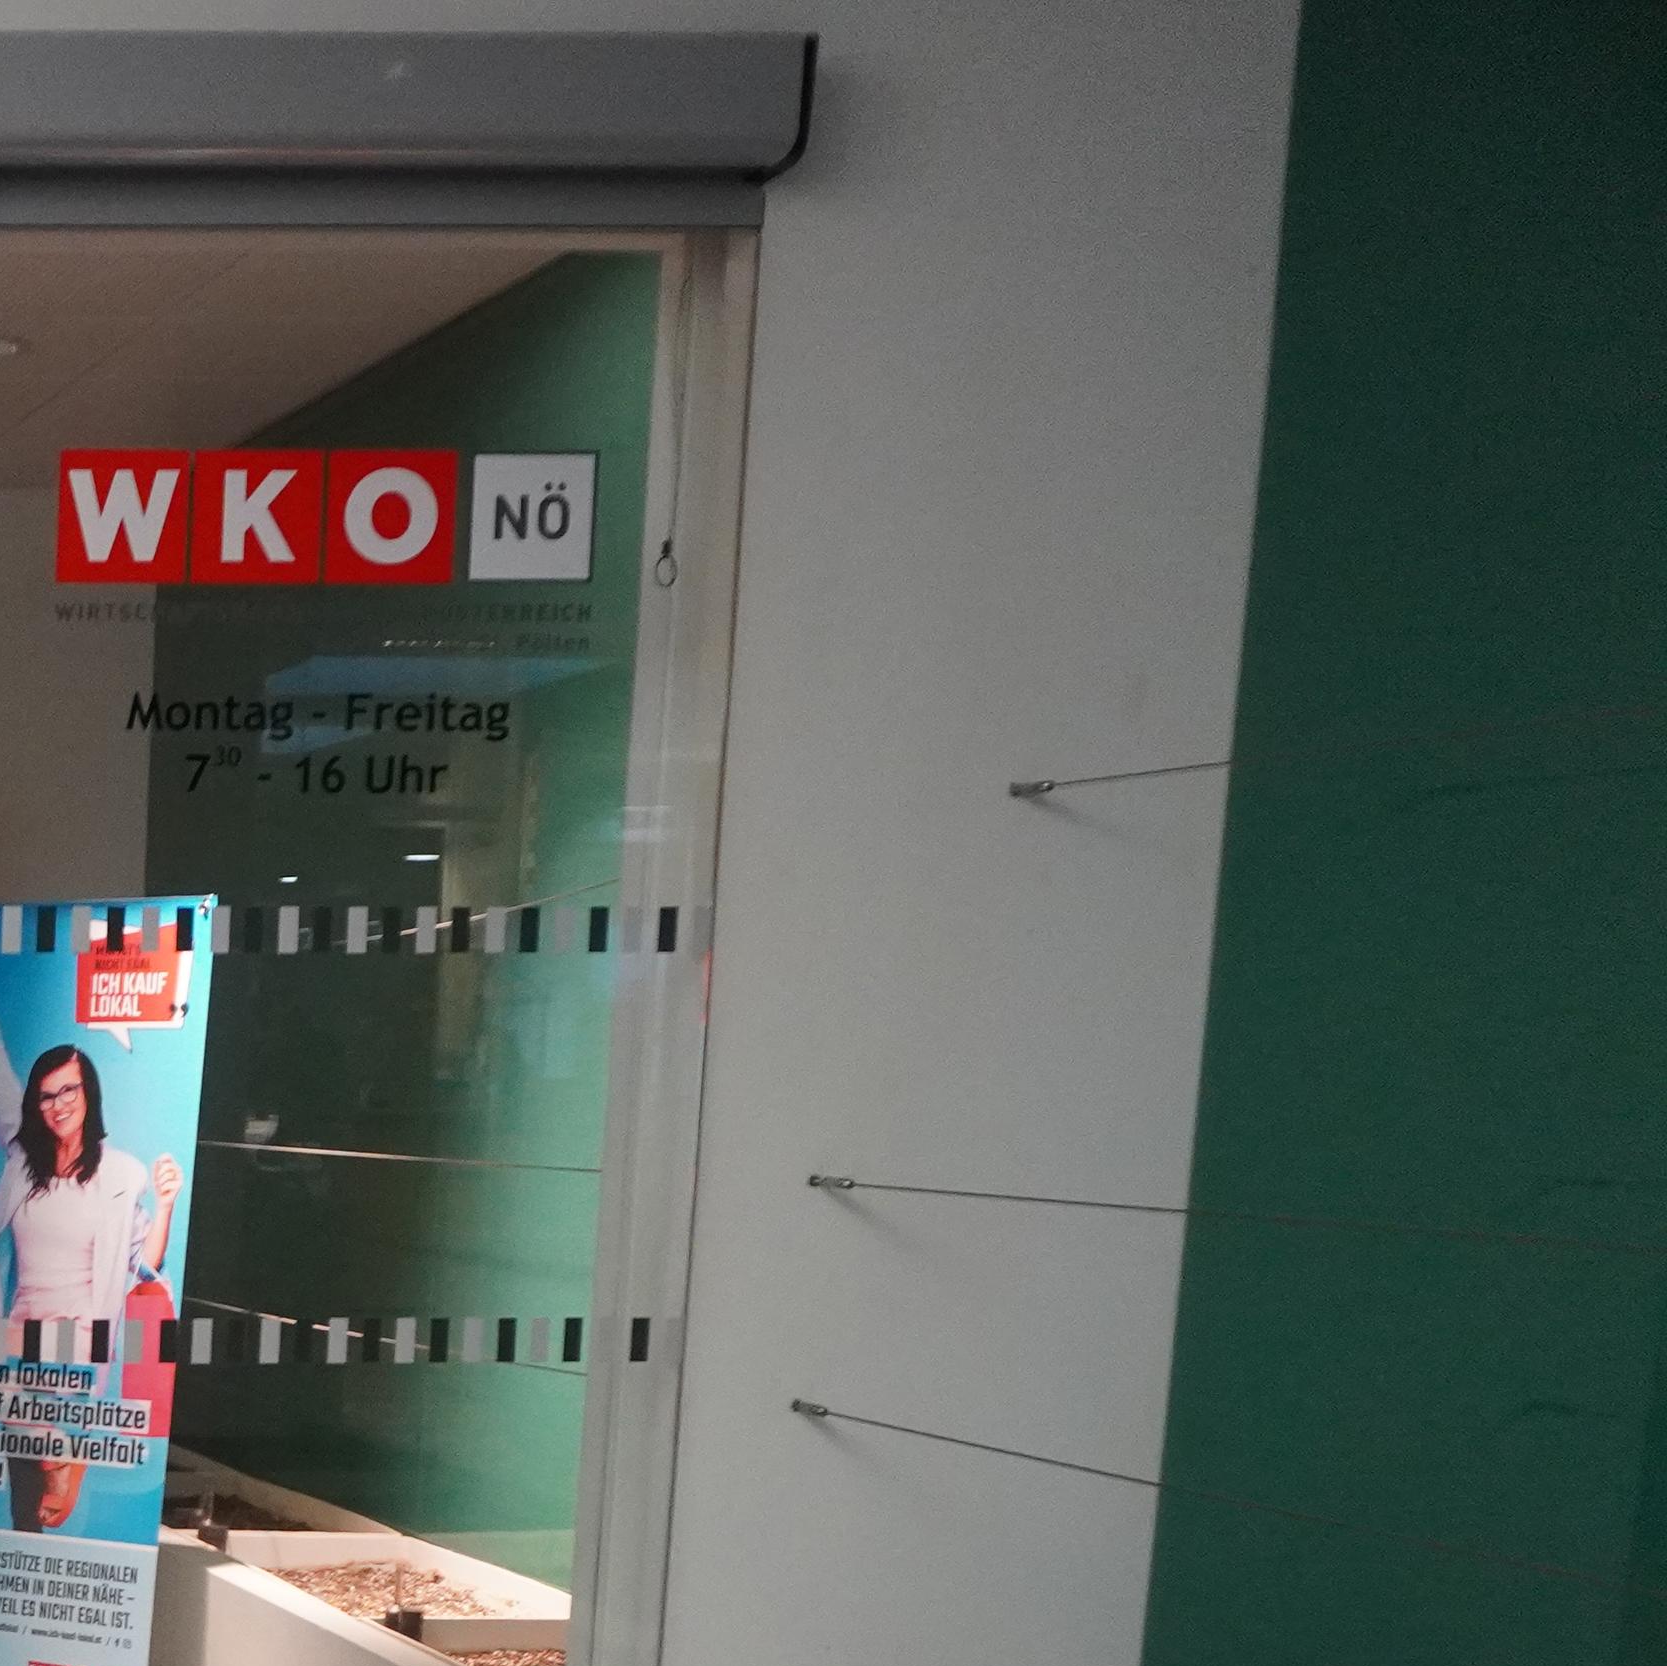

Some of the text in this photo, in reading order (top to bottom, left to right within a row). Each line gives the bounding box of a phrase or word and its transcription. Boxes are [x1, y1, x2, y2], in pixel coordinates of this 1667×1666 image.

[69, 467, 571, 564] WKO NÖ
[125, 691, 294, 741] Montag
[344, 692, 511, 742] Freitag
[295, 755, 345, 794] 16
[367, 753, 449, 794] Uhr
[92, 971, 168, 995] ICH KAUF
[90, 995, 143, 1018] LOKAL
[17, 1364, 92, 1390] lokalen
[7, 1395, 146, 1430] Arbeitsplätze
[69, 1434, 146, 1465] Vielfalt
[44, 1557, 64, 1576] DIE
[65, 1559, 139, 1584] REGIONALEN
[32, 1579, 44, 1596] IN
[47, 1580, 89, 1601] DEINER
[92, 1584, 124, 1605] NÄHE
[21, 1599, 35, 1617] ES
[39, 1602, 75, 1622] NICHT
[78, 1607, 107, 1627] EGAL
[111, 1611, 133, 1630] IST.
